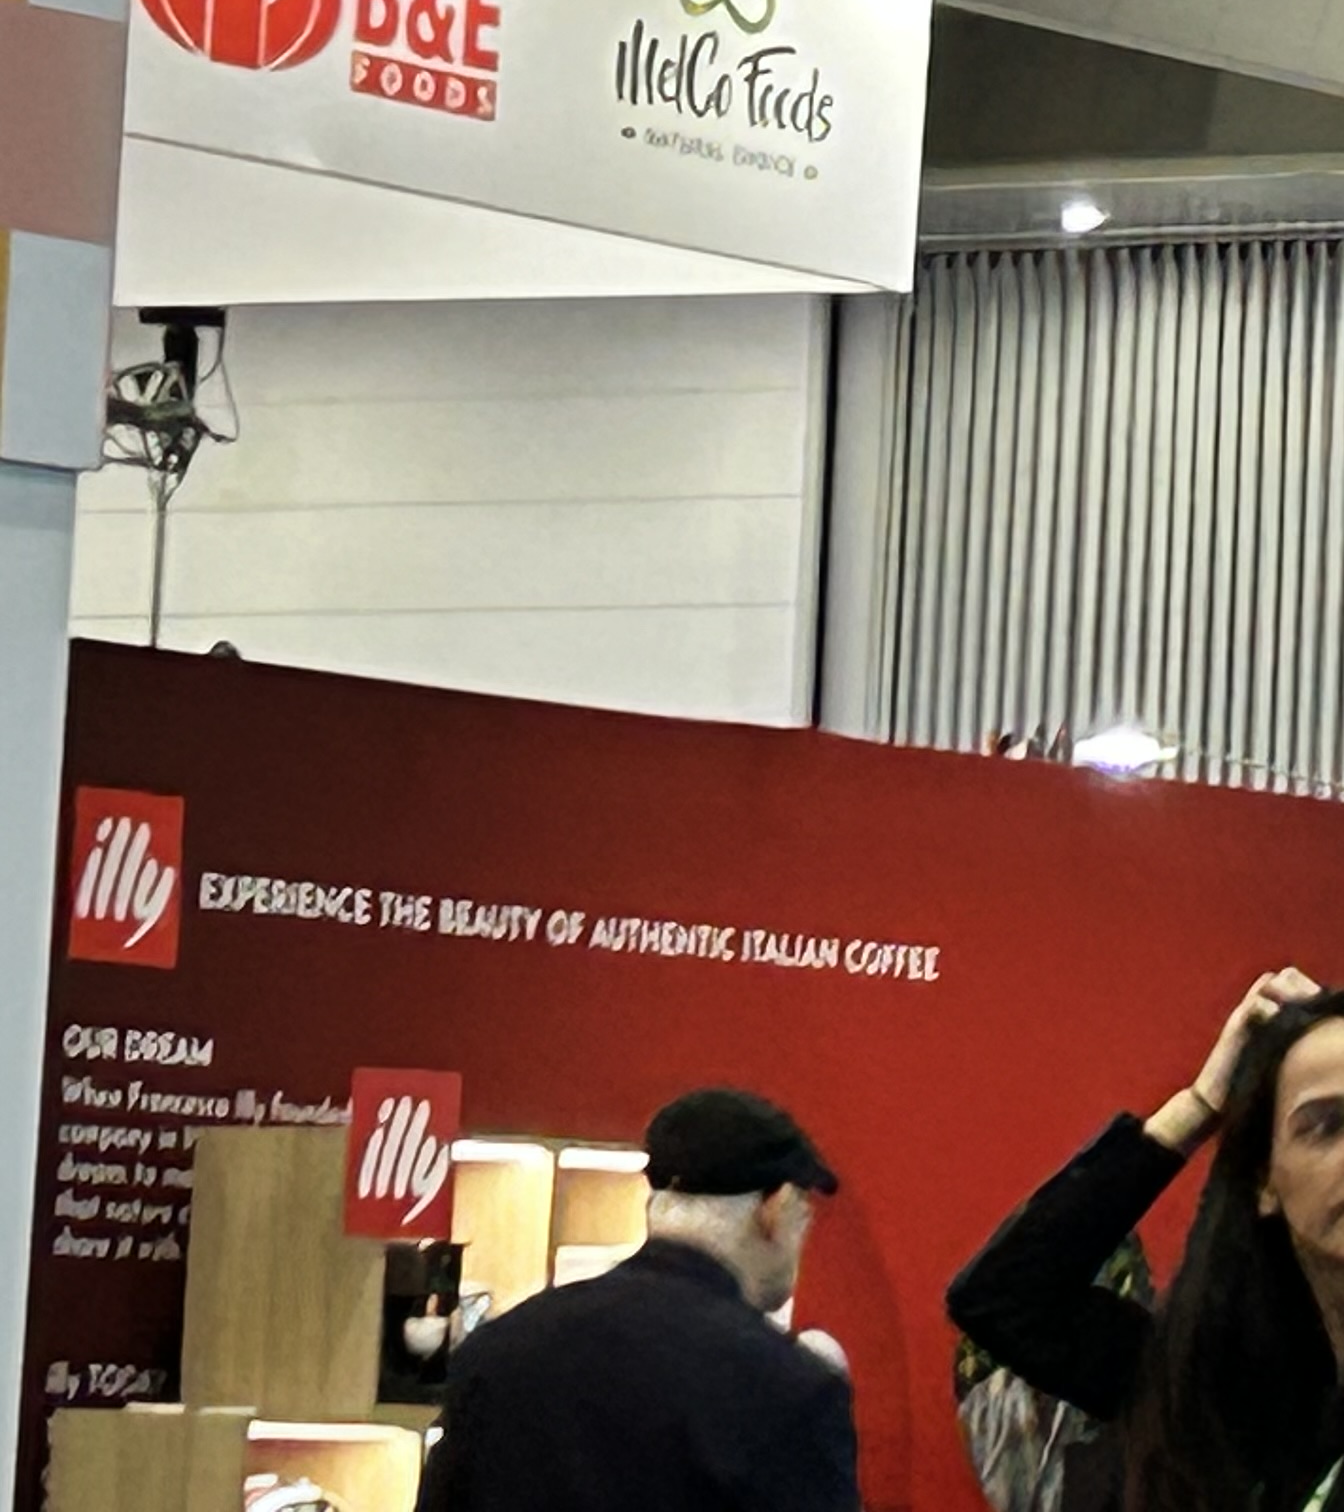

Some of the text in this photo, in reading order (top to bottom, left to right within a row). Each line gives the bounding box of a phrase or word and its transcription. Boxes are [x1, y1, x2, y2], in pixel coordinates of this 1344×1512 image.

[352, 55, 496, 116] FOODS
[74, 815, 176, 950] illy
[200, 871, 942, 982] EXPERIENCE THE BEAUTY OF AUTHENTIC ITALIAN COFFEE
[358, 1095, 449, 1226] illy
